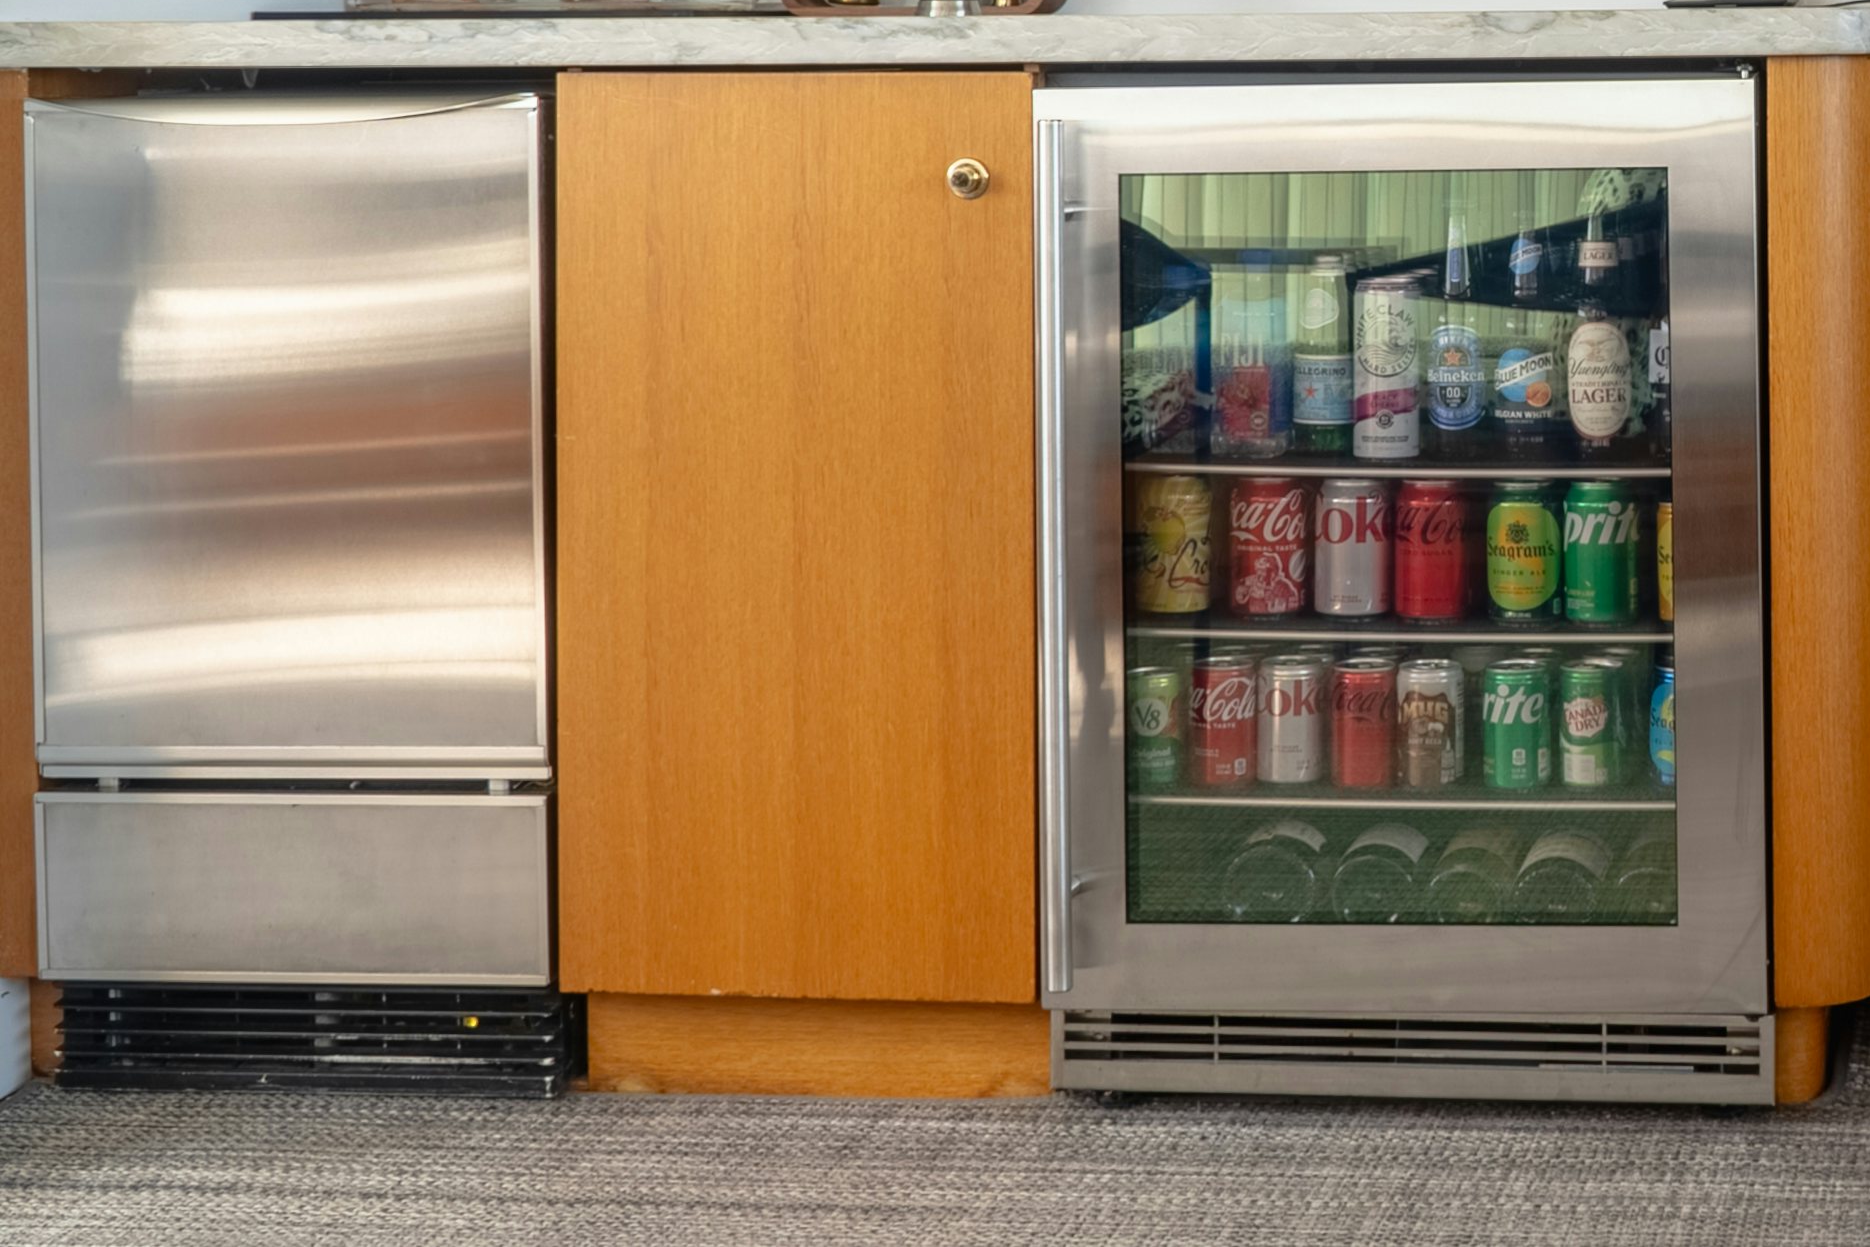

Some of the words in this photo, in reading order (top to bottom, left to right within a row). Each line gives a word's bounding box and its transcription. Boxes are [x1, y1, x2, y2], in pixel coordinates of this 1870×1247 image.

[1376, 304, 1414, 327] CLAW
[1427, 369, 1485, 383] Heineken
[1519, 353, 1552, 376] MOON
[1571, 388, 1627, 404] LAGER
[1487, 536, 1555, 562] Seagram's
[1135, 701, 1161, 731] V8
[1401, 700, 1450, 724] MUG
[1574, 717, 1601, 732] DRY
